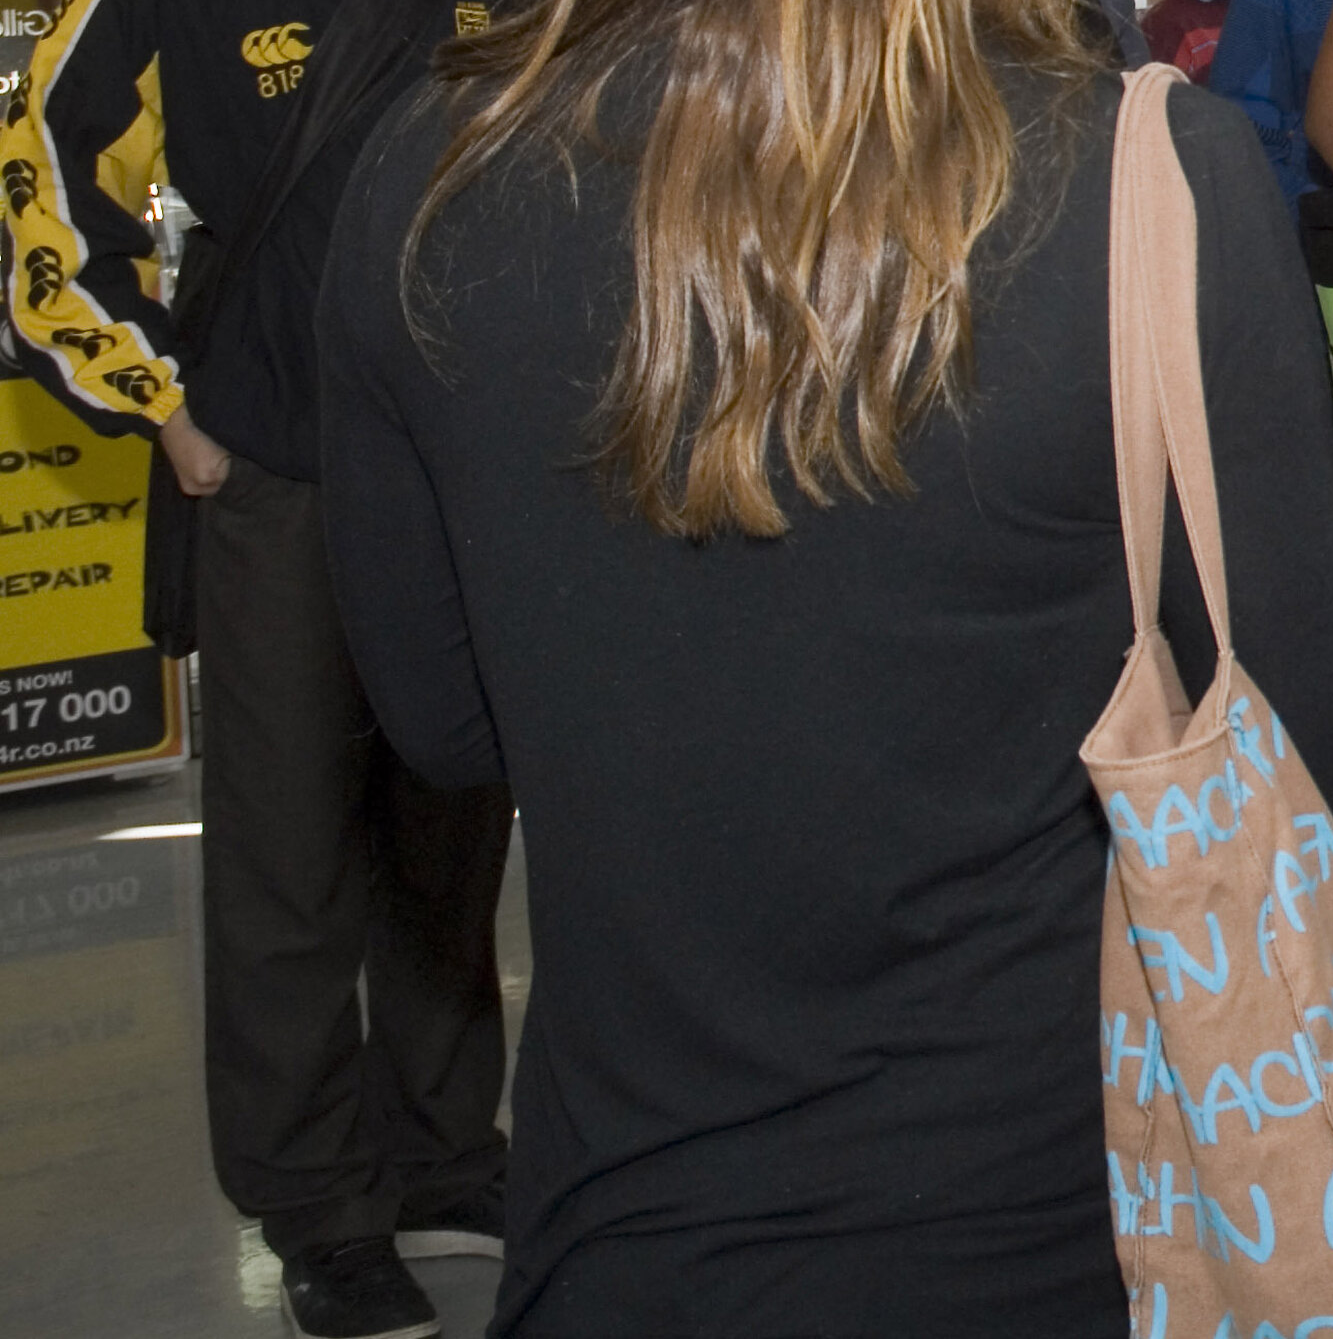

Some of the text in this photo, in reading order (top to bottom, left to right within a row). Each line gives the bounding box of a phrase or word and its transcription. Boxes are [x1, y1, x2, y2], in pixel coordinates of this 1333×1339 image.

[0, 563, 113, 598] EPAIR
[16, 670, 73, 693] NOW!
[1, 685, 131, 731] 17 000
